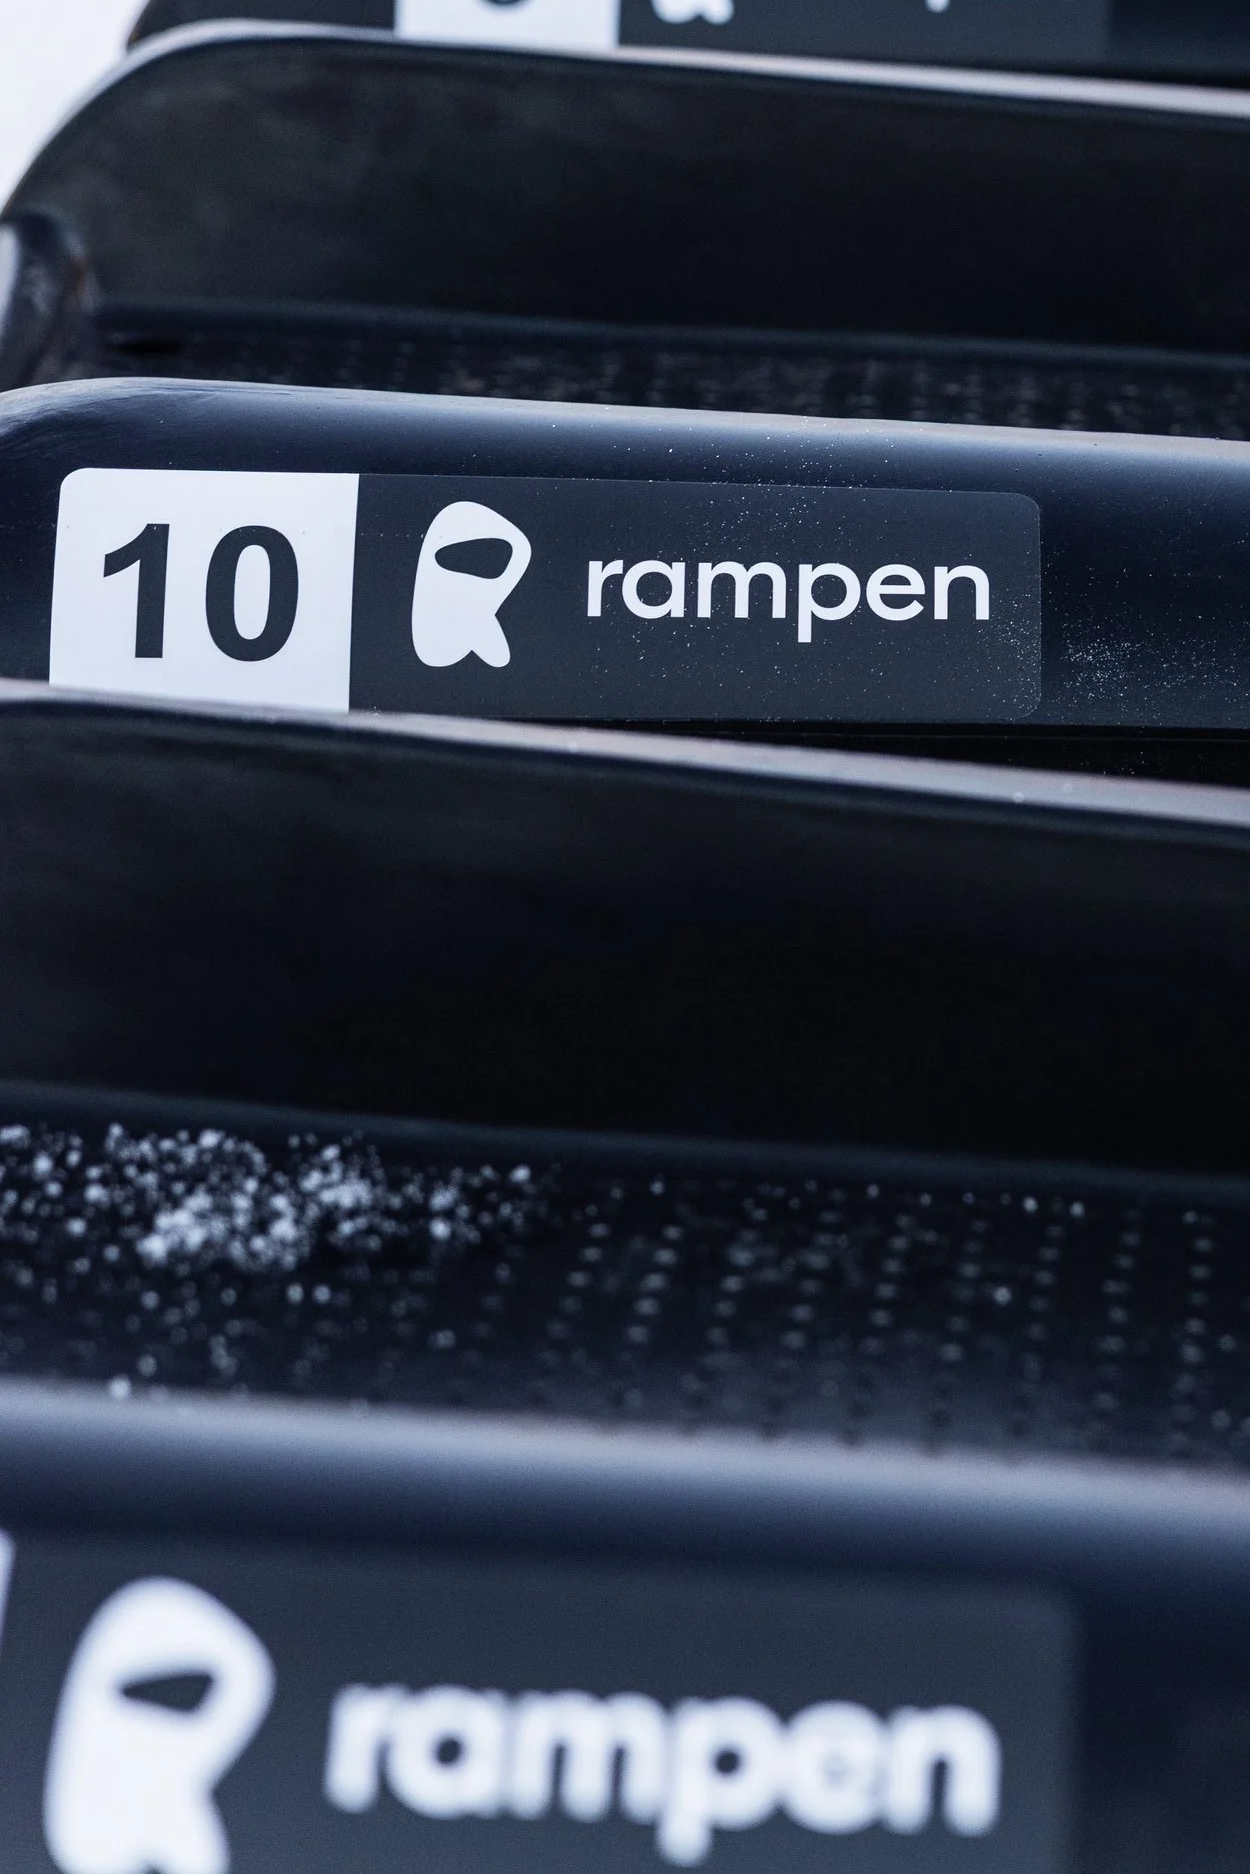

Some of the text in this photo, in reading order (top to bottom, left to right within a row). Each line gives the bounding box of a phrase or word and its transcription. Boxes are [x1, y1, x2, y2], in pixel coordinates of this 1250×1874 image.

[102, 522, 991, 663] 10 rampen
[325, 1681, 1000, 1866] rampen
